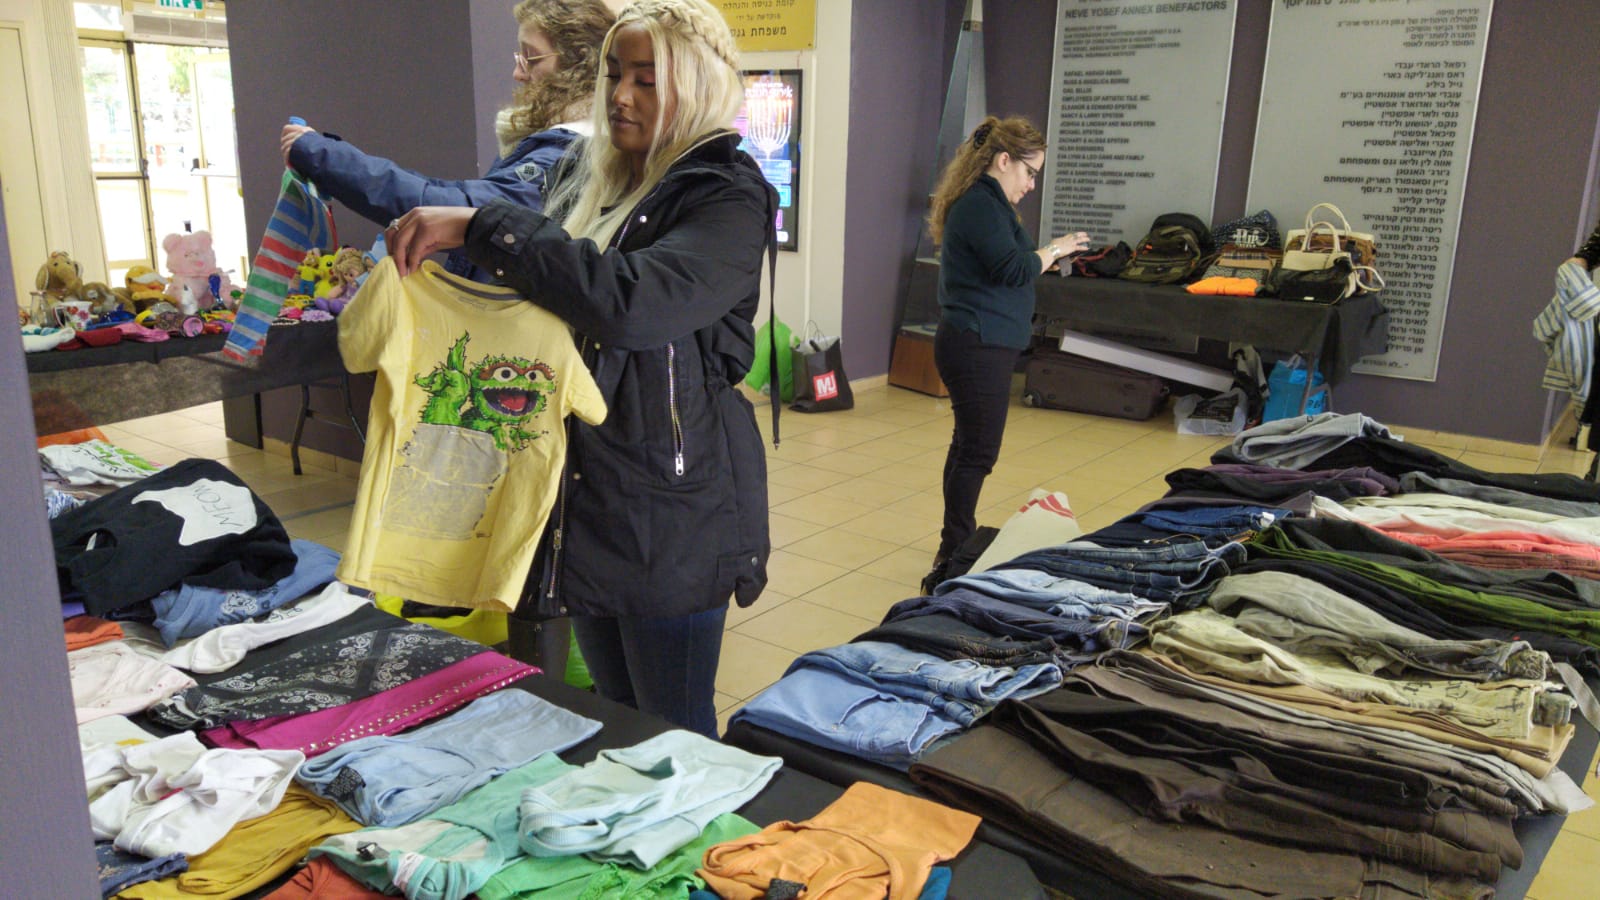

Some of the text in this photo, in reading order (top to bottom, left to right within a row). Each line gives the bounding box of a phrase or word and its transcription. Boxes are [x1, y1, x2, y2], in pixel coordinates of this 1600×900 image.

[1065, 1, 1227, 19] NEVE YOSEF ANNEX BENEFACTORS
[751, 26, 787, 37] משפחת
[816, 374, 836, 397] MJ
